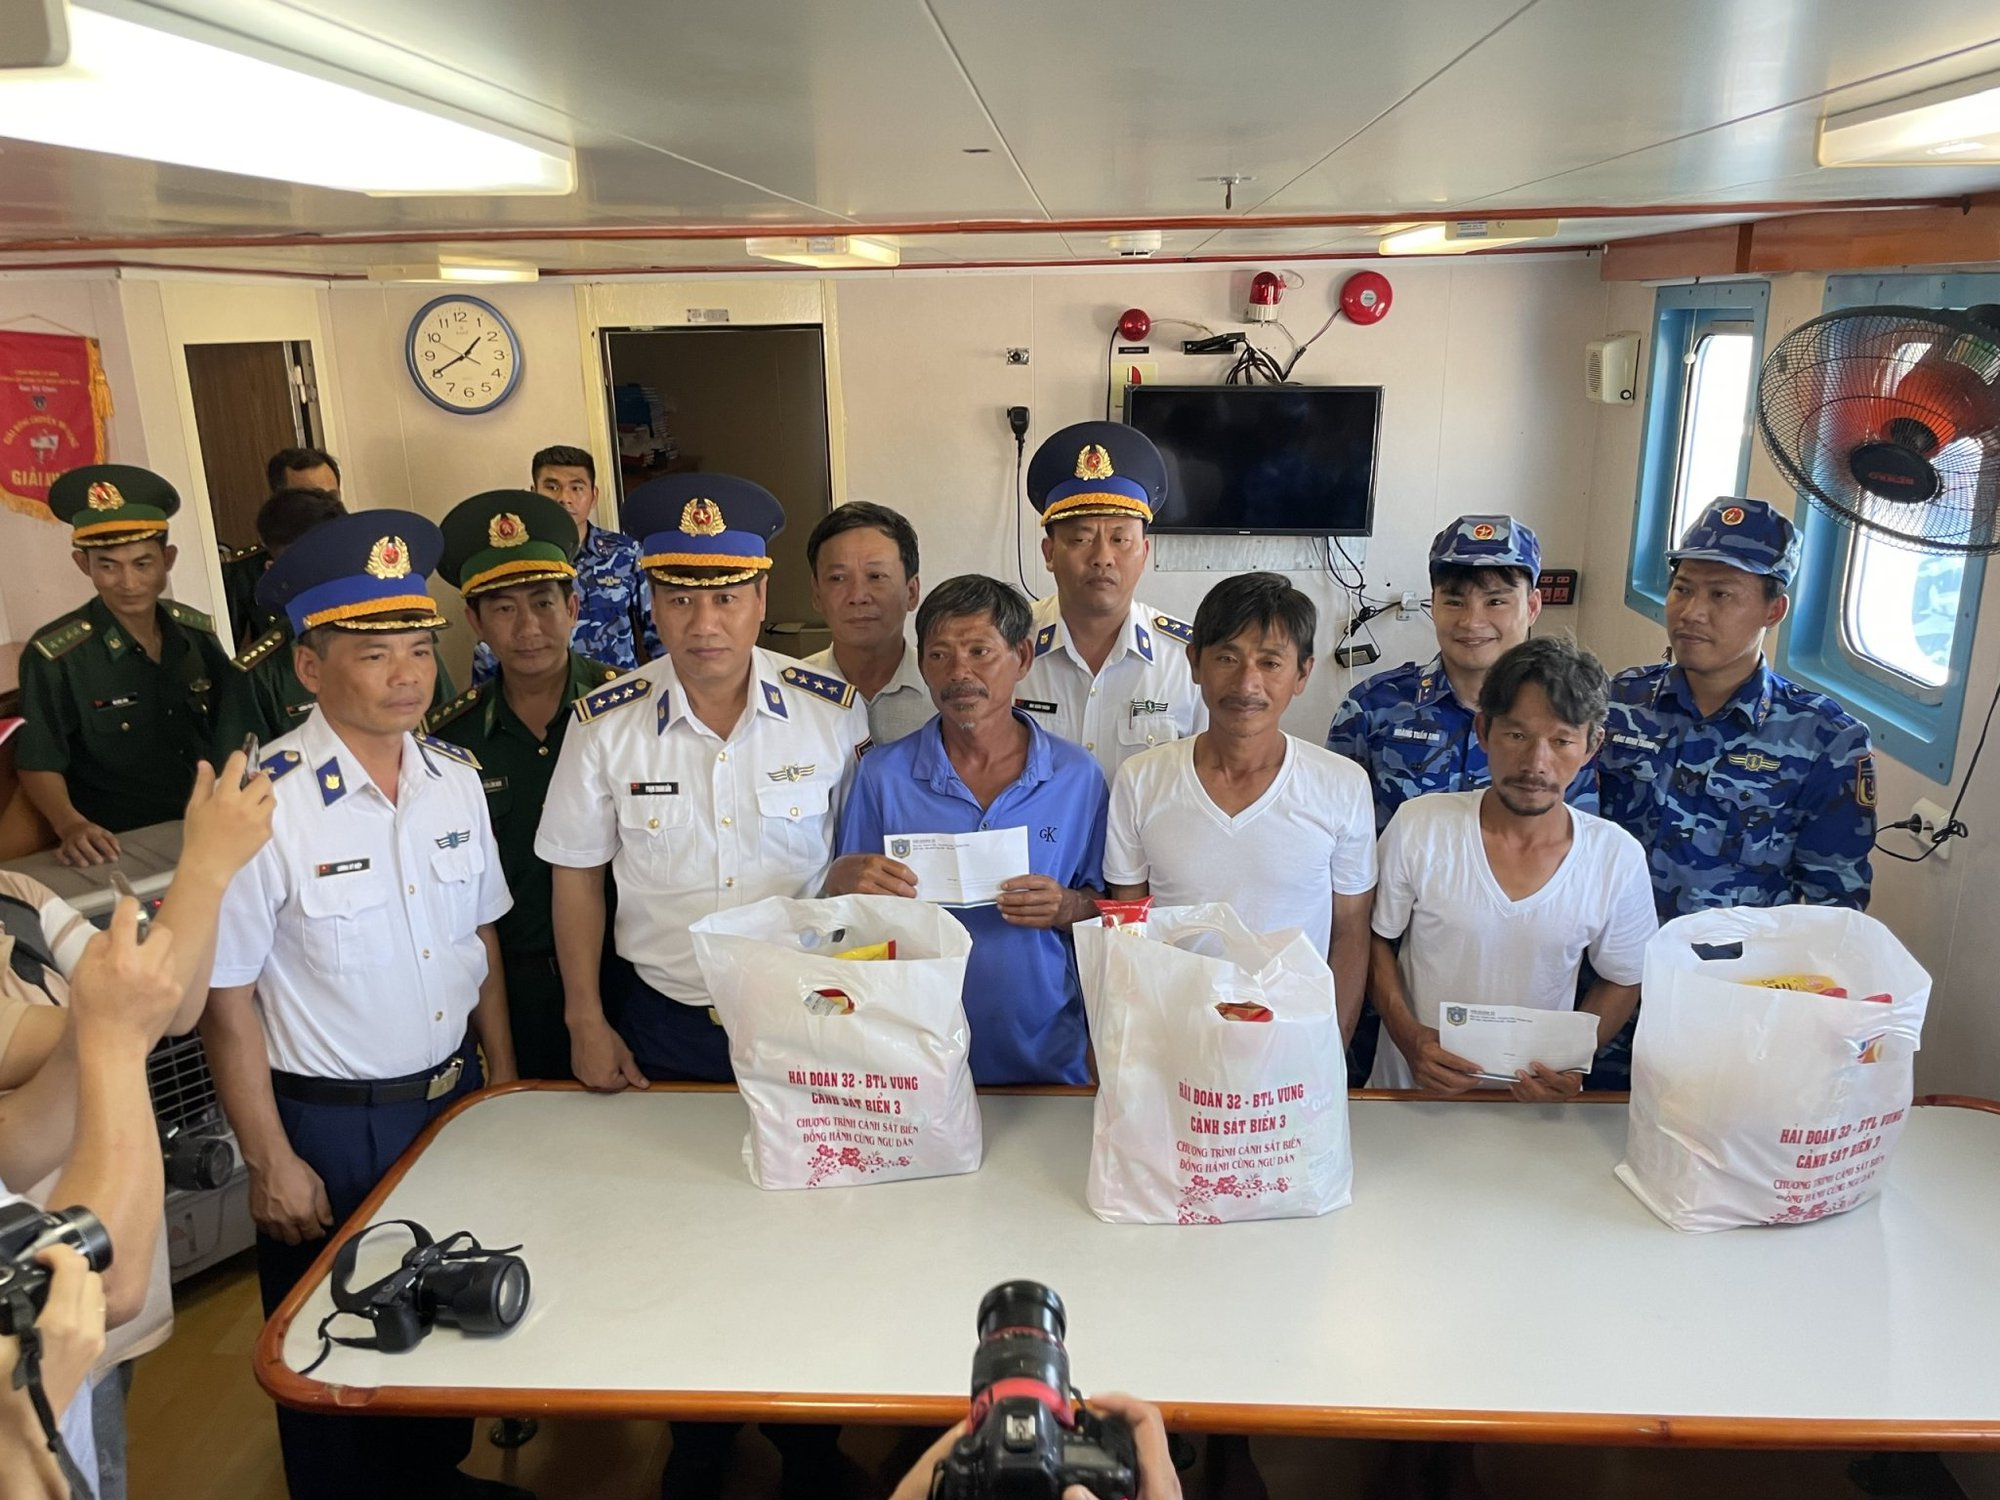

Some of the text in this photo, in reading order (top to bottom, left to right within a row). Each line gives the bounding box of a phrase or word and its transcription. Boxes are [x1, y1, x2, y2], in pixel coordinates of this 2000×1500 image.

[453, 312, 467, 322] 12
[477, 317, 481, 328] 1
[439, 318, 449, 328] 11
[427, 332, 441, 343] 10
[487, 331, 498, 342] 2
[424, 350, 436, 361] 9
[494, 350, 505, 360] 3
[432, 368, 443, 379] 8
[491, 368, 501, 378] 4
[446, 382, 456, 393] 7
[463, 387, 475, 398] 6
[481, 382, 492, 392] 5
[841, 1073, 855, 1088] 32
[865, 1074, 888, 1089] BTL
[1227, 1093, 1241, 1109] 32
[1253, 1091, 1274, 1108] BTL
[894, 1100, 901, 1115] 3
[1279, 1114, 1286, 1128] 3
[1838, 1124, 1852, 1139] 32
